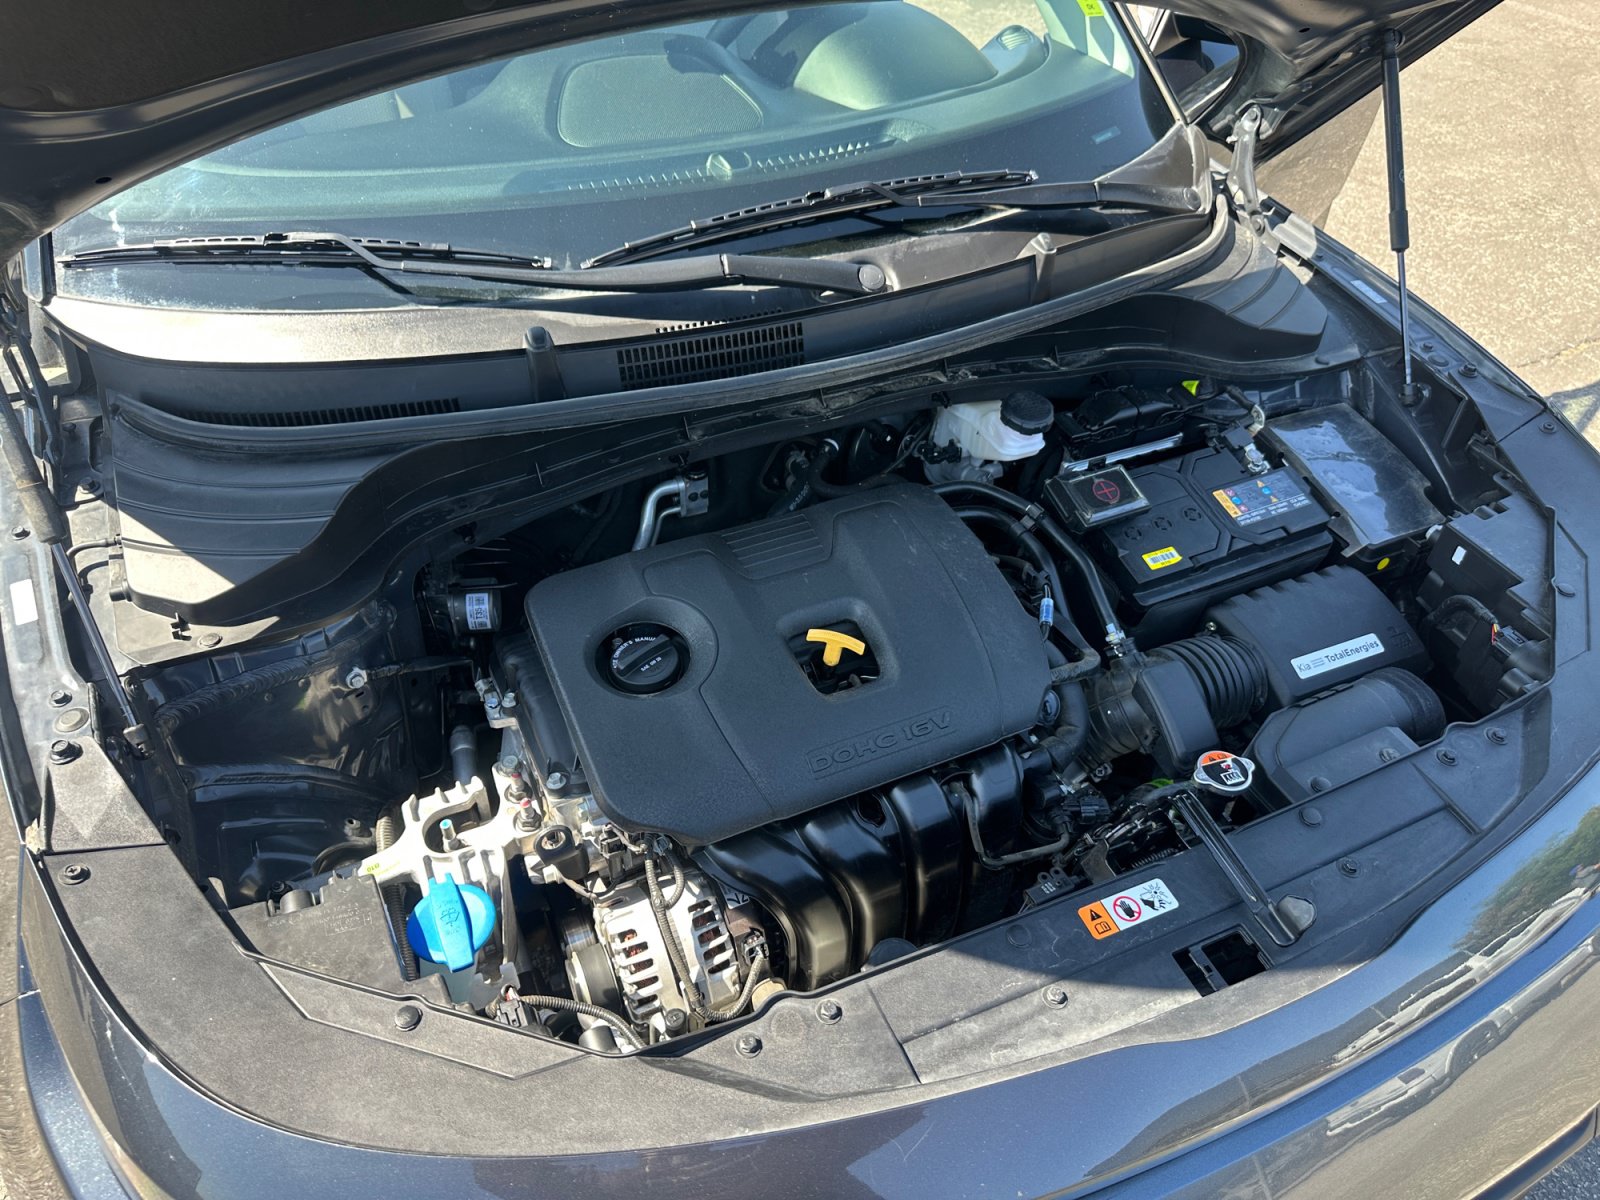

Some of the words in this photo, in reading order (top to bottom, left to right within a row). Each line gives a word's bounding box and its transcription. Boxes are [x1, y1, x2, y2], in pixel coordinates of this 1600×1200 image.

[613, 640, 633, 658] OWNER'S
[1296, 661, 1312, 673] Kia
[1324, 640, 1380, 663] TotalEnergies
[808, 732, 898, 773] DOHC
[902, 710, 950, 741] 16V
